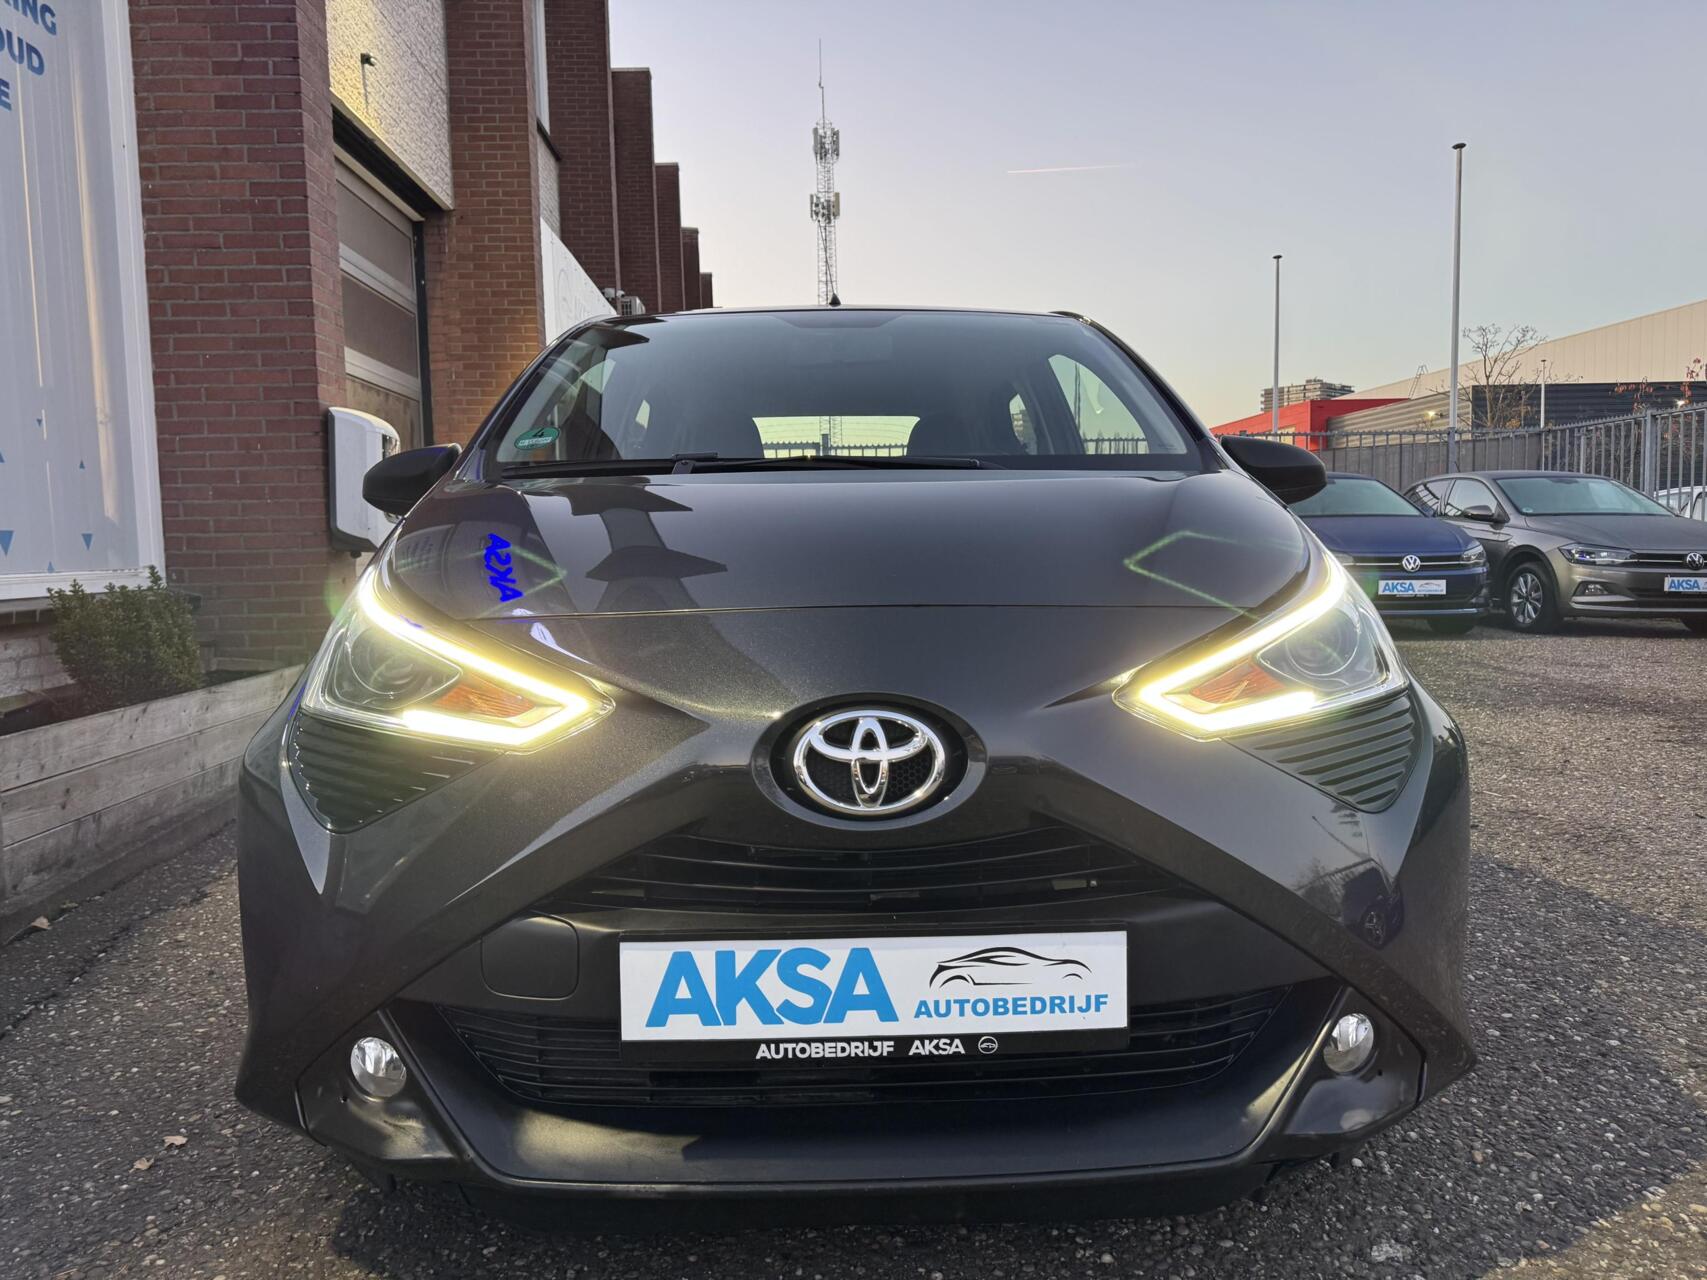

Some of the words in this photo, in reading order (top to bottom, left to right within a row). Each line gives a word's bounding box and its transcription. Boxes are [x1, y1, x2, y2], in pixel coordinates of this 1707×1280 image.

[0, 26, 45, 76] UD
[1382, 581, 1416, 593] AKSA
[1668, 578, 1700, 591] AKSA
[645, 947, 900, 1027] AKSA
[913, 993, 1109, 1019] AUTOBEDRIJF
[755, 1040, 895, 1060] AUTOBEDRIJF
[908, 1038, 966, 1057] AKSA
